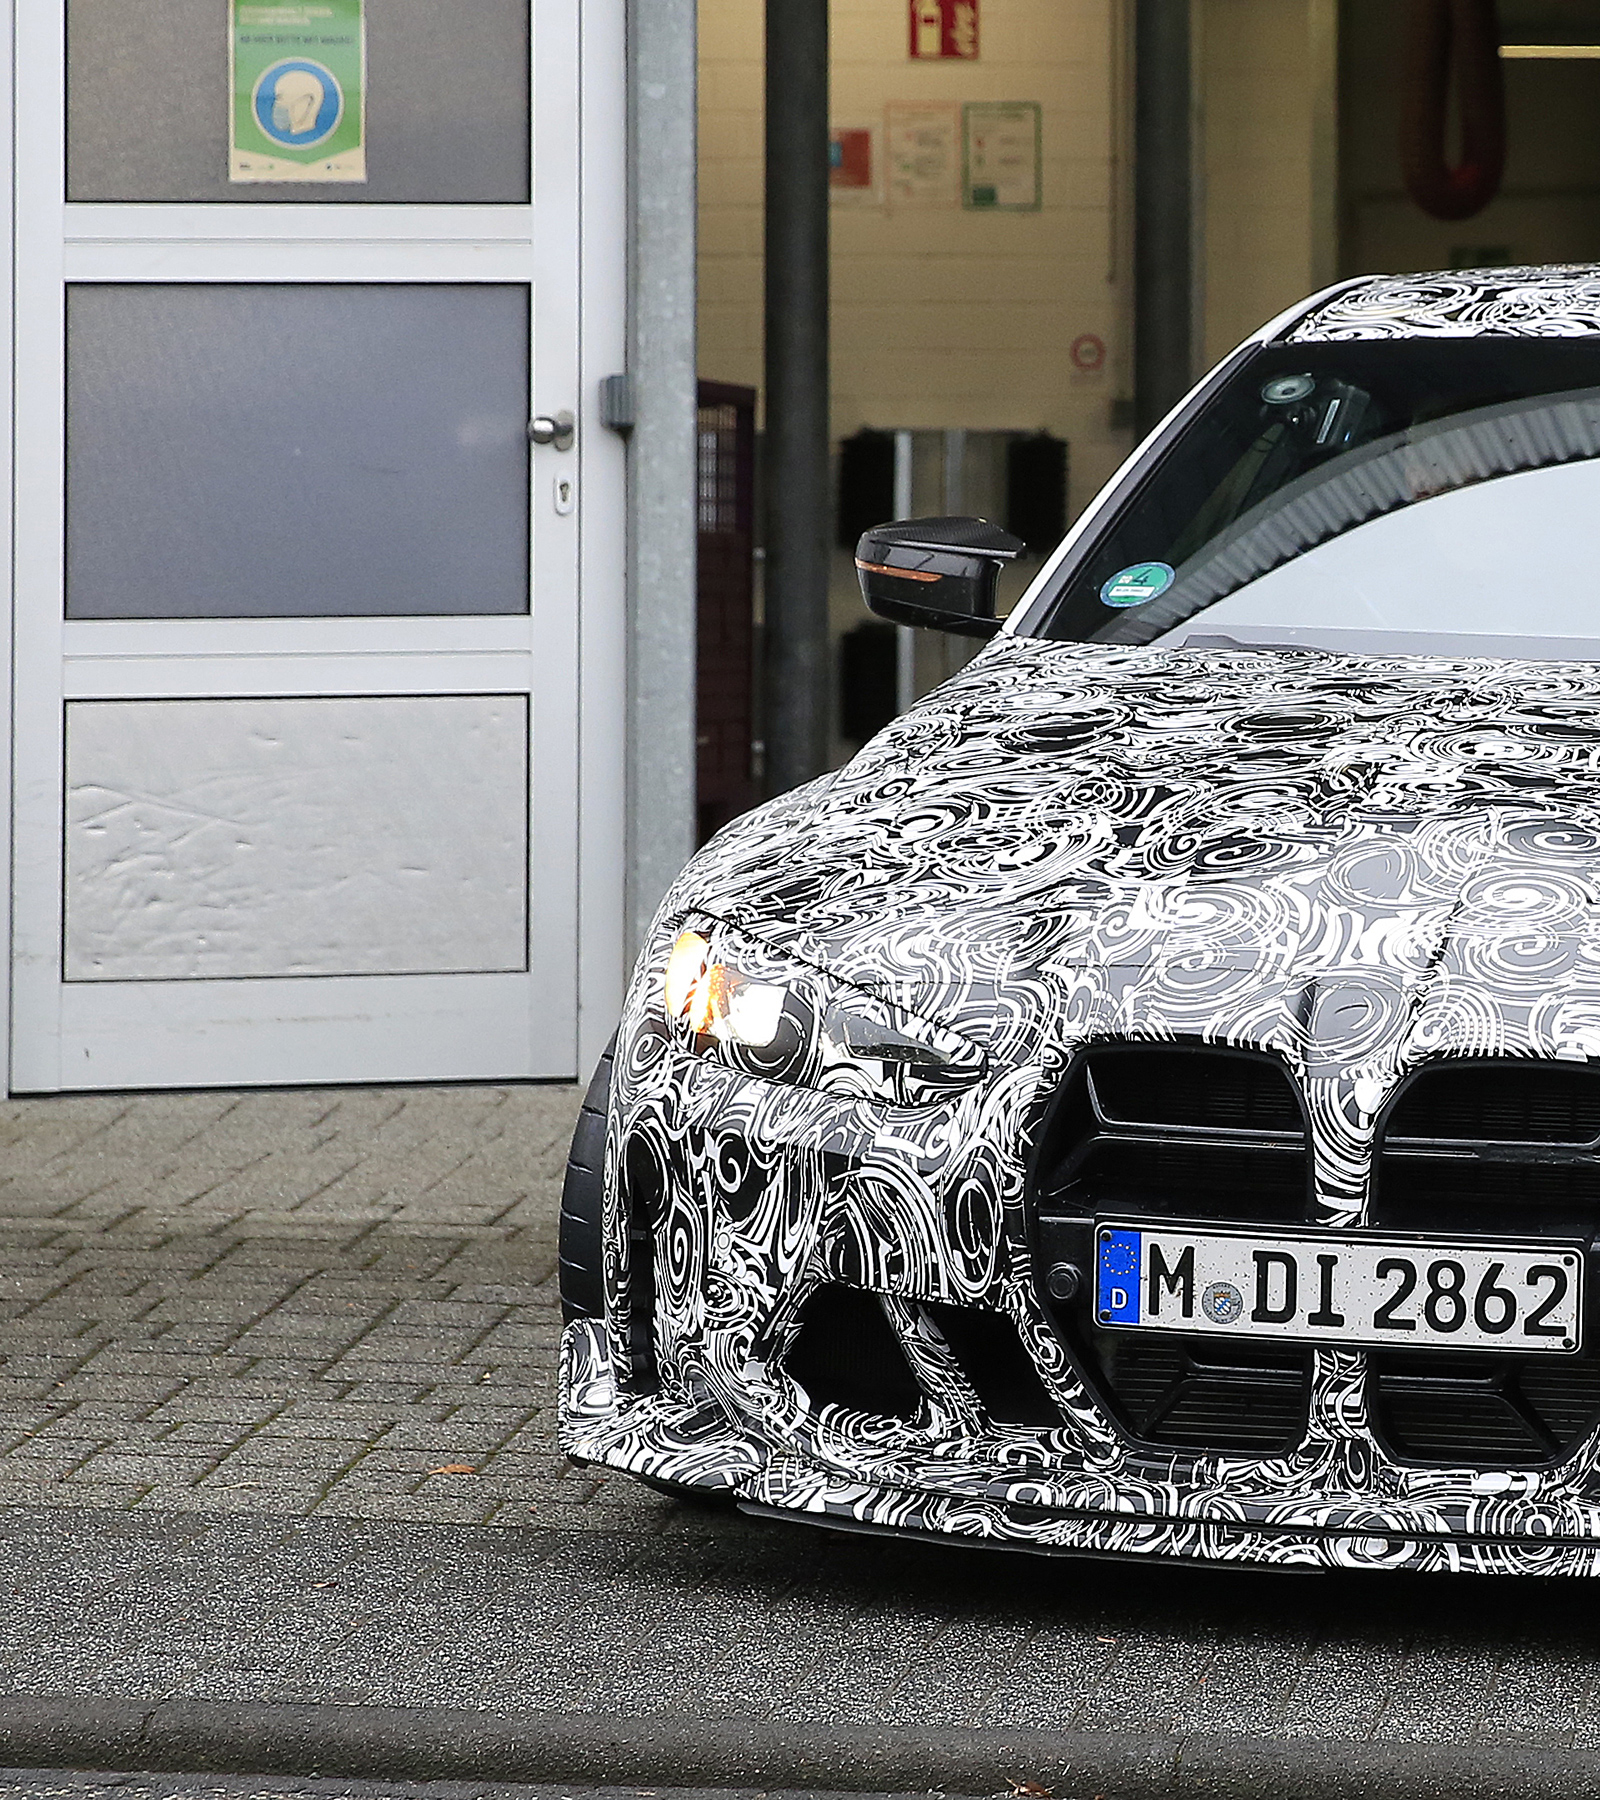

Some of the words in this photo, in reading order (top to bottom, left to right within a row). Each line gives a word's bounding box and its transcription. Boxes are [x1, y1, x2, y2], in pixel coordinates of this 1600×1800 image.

[1131, 568, 1154, 586] 4
[1112, 1287, 1127, 1310] D
[1147, 1242, 1195, 1319] M
[1251, 1249, 1345, 1328] DI
[1373, 1258, 1567, 1337] 2862
